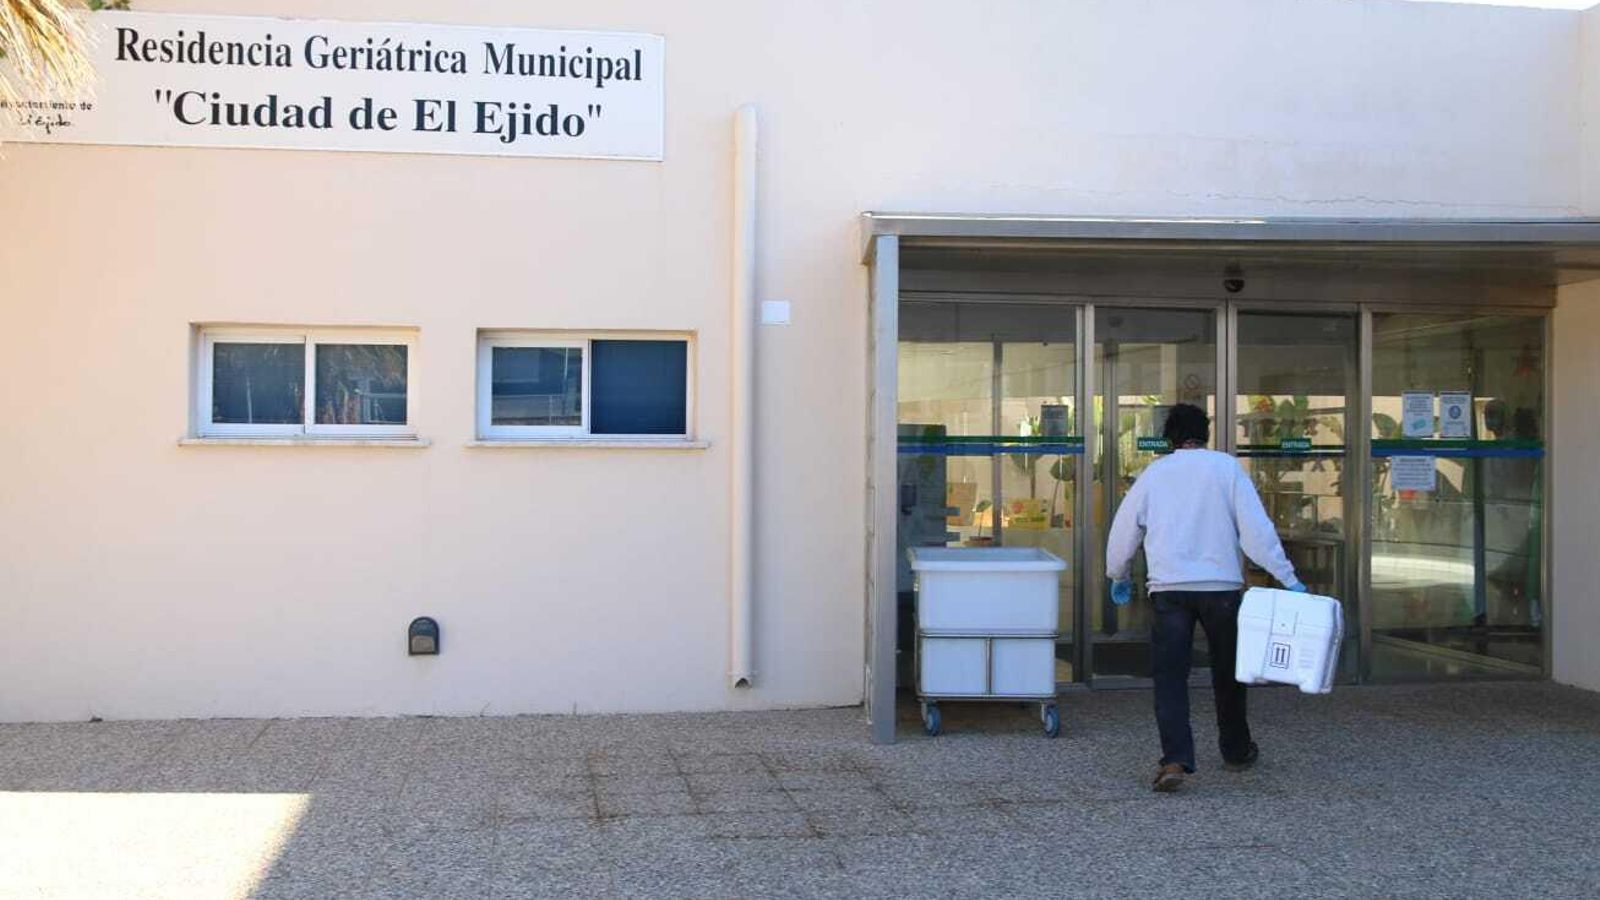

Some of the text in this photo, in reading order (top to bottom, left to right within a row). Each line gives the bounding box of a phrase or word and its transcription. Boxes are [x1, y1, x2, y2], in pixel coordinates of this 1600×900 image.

[115, 27, 642, 89] Residencia Geriátrica Municipal
[154, 89, 602, 144] "Ciudad de El Ejido"
[1138, 439, 1169, 449] ENTRADA
